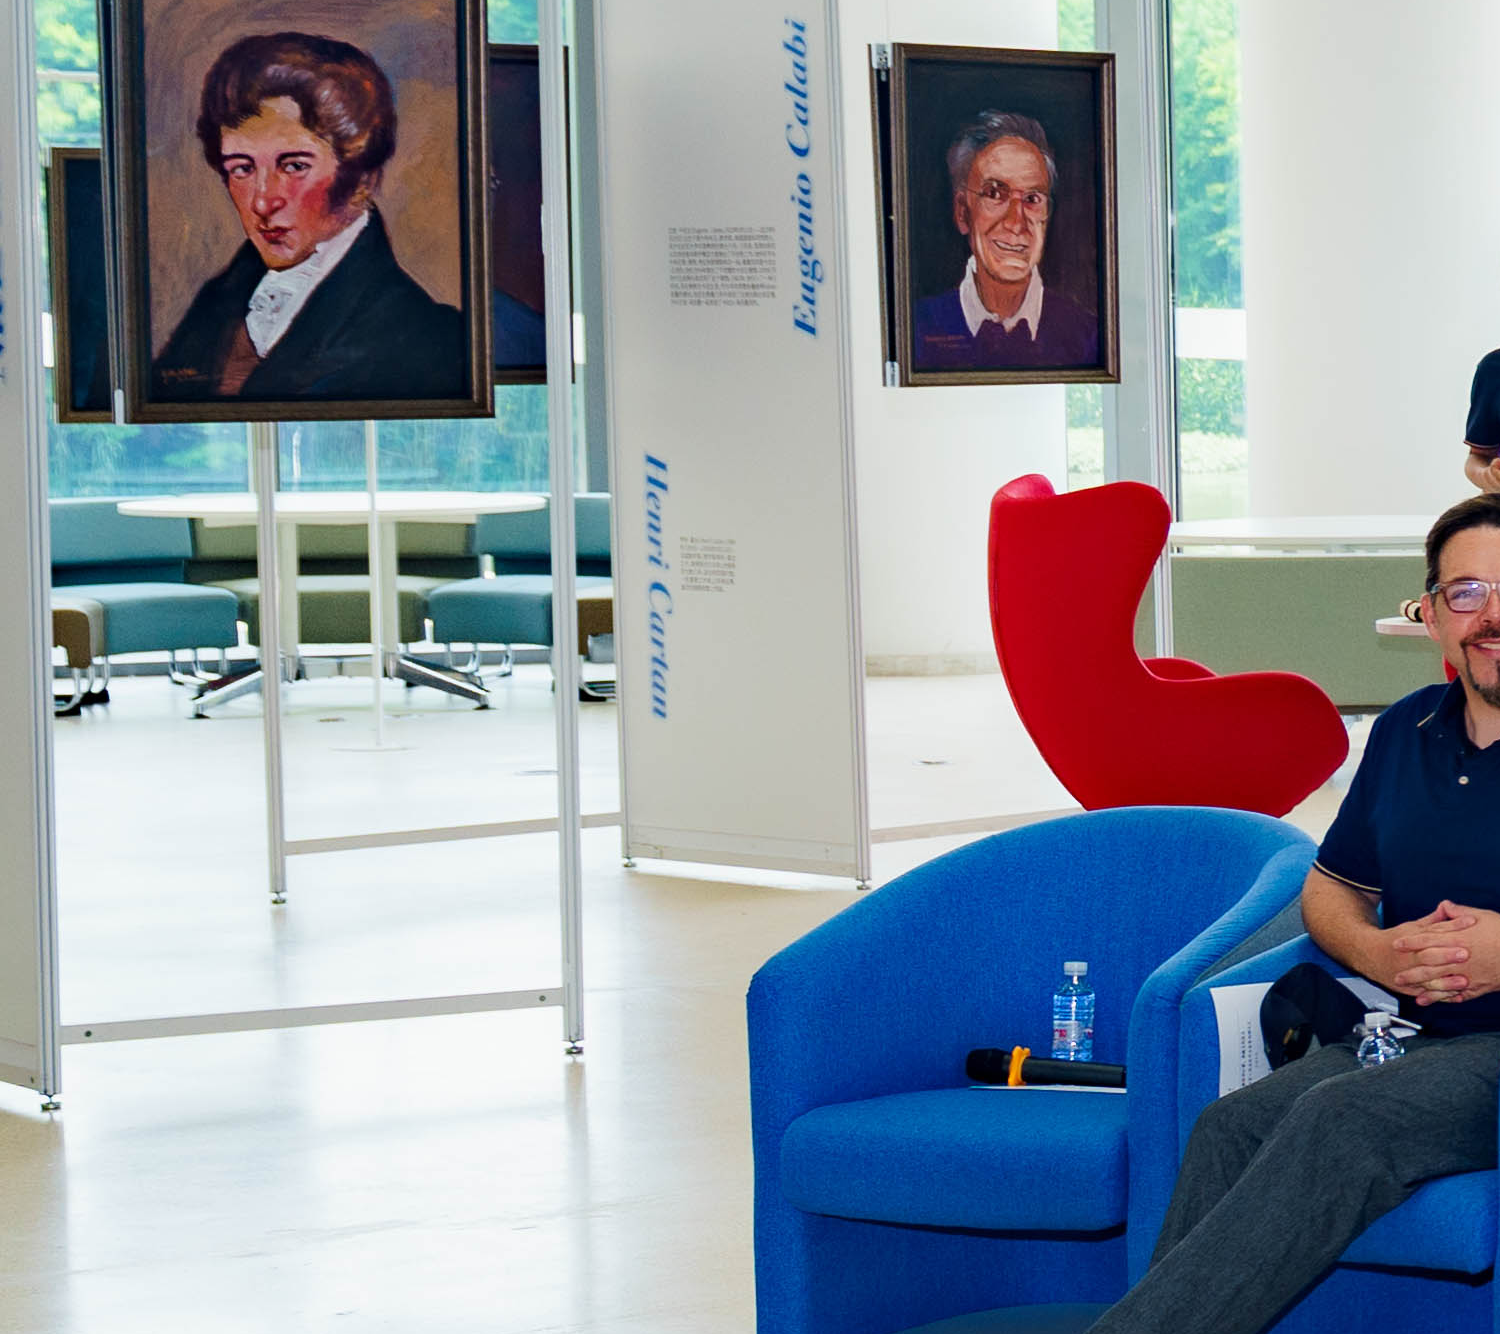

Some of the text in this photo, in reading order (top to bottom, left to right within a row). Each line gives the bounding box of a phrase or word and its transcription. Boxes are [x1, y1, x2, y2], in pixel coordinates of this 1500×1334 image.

[782, 16, 825, 338] Eugenio Calabi
[645, 454, 674, 720] Henri Cartan
